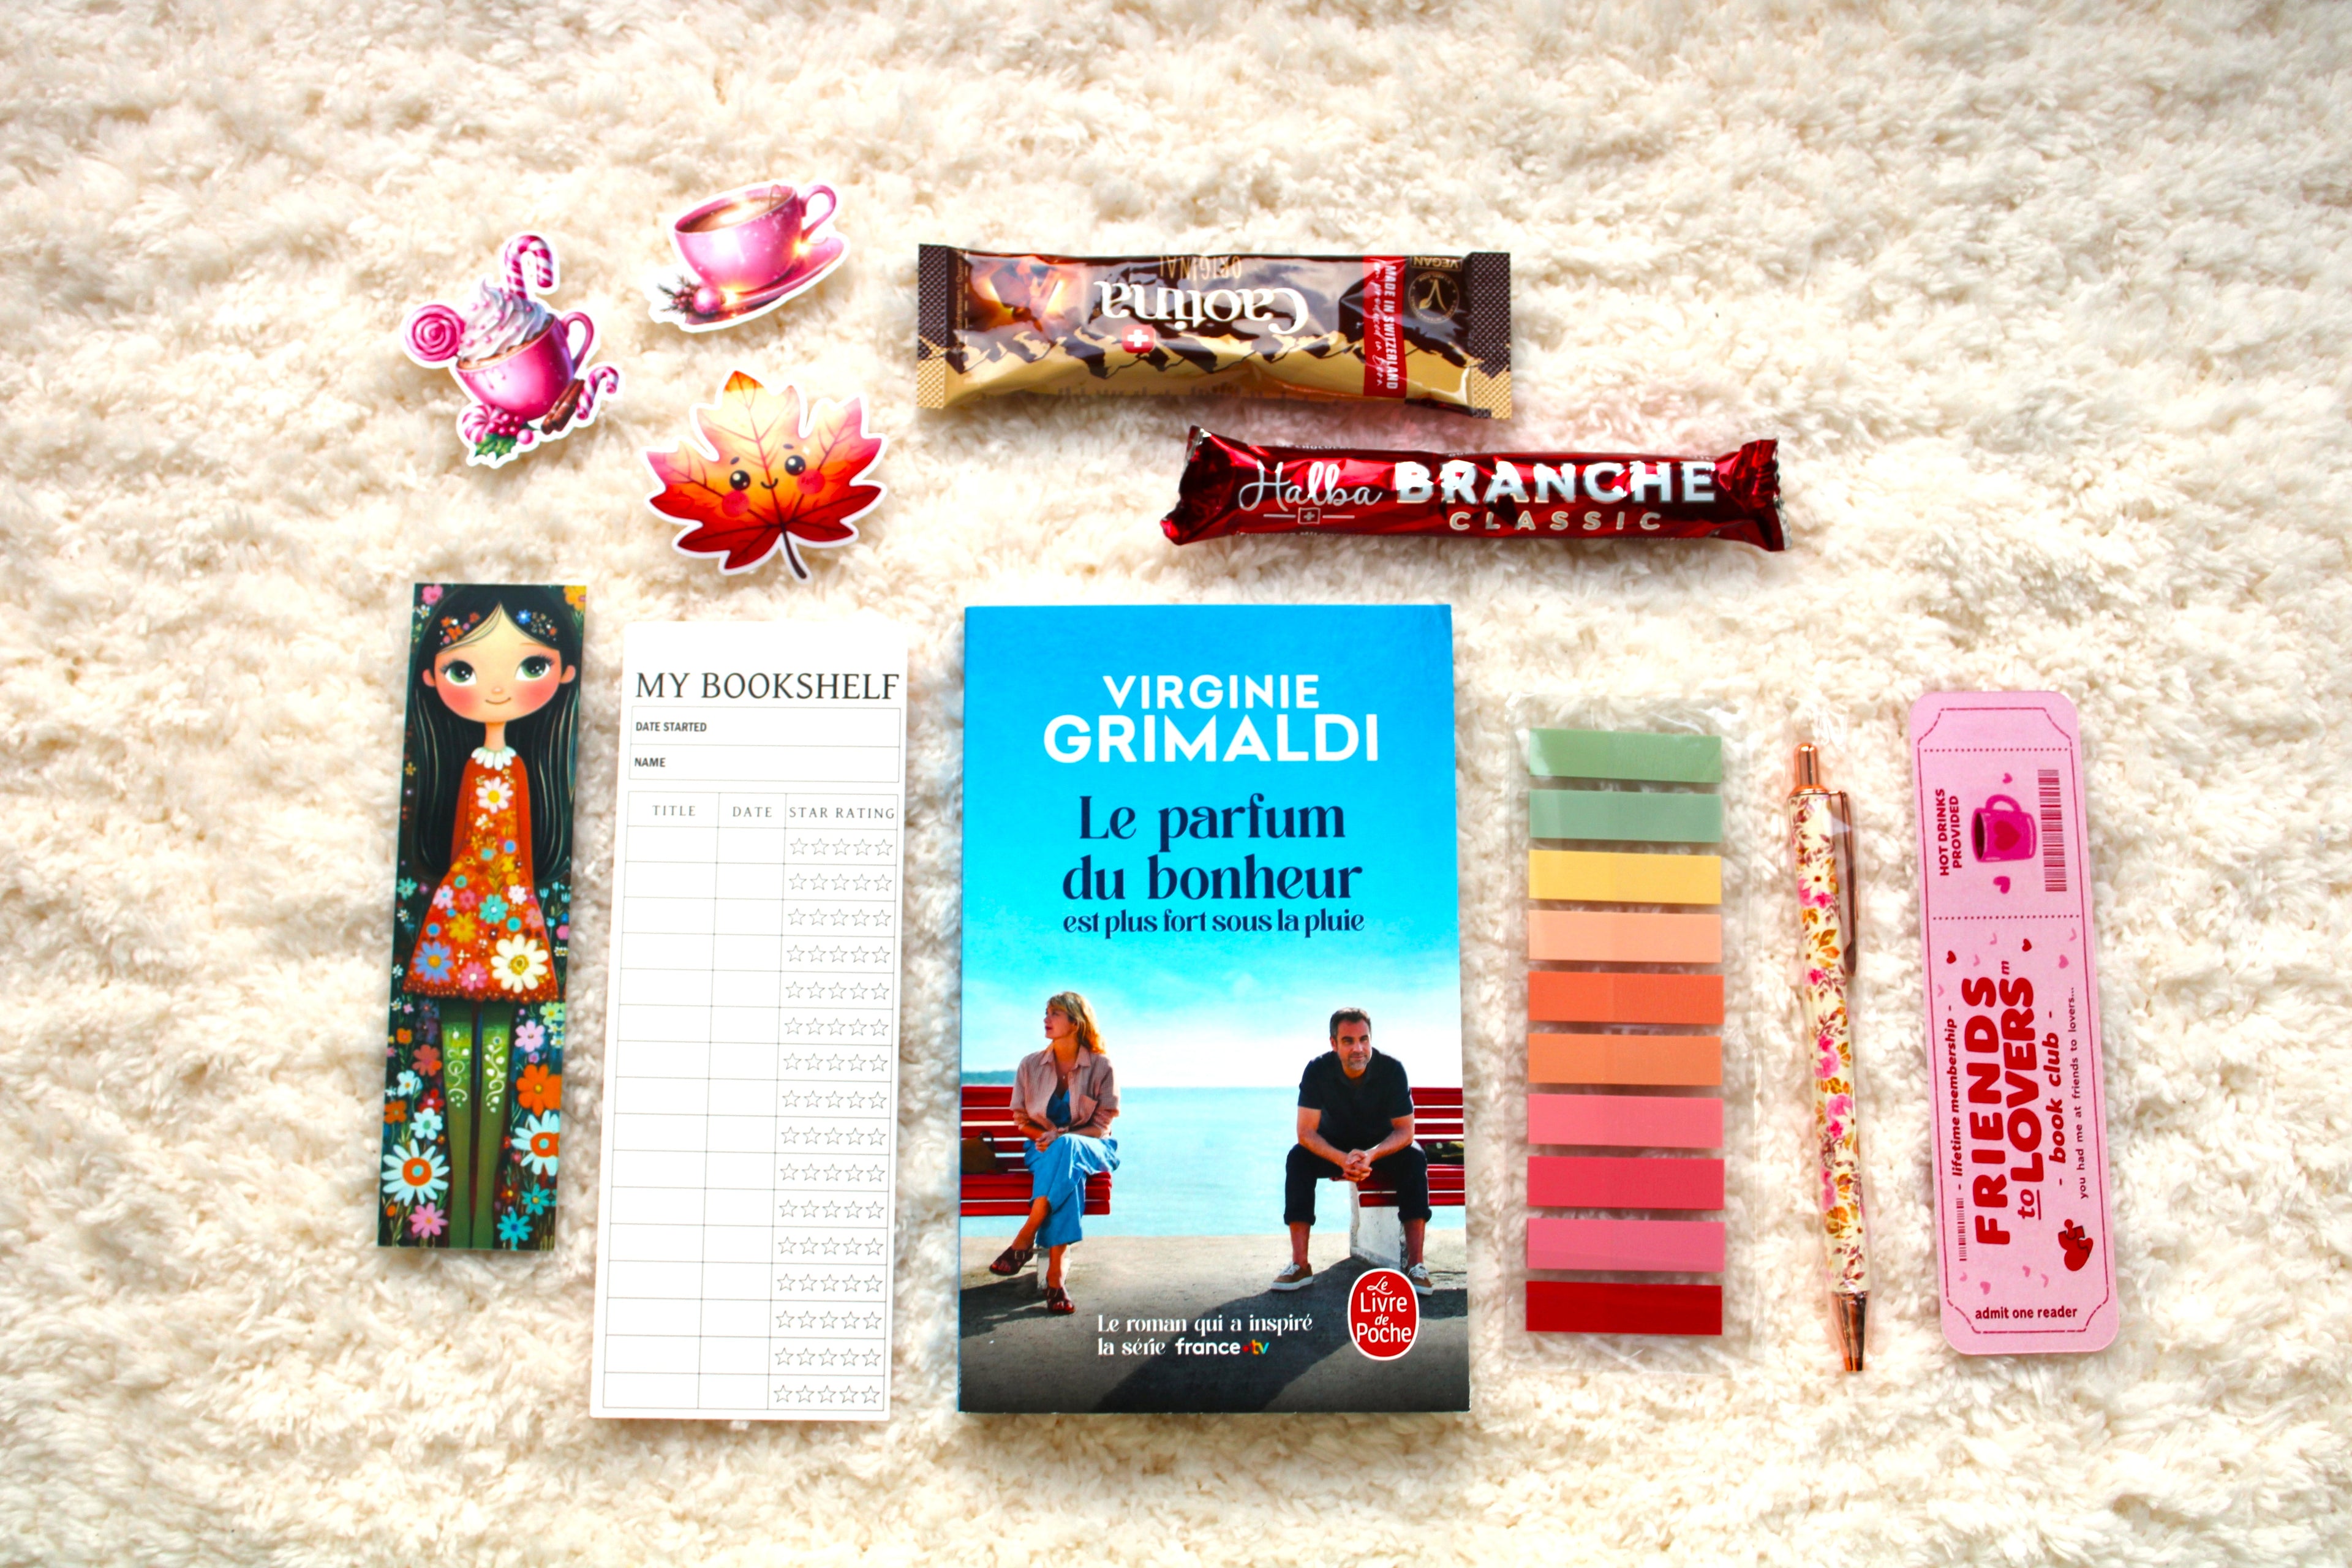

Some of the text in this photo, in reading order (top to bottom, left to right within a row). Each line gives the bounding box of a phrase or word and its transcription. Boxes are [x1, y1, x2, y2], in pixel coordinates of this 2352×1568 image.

[1413, 256, 1459, 268] VEGAN
[1093, 281, 1309, 334] Caotina
[1382, 265, 1398, 390] MADE IN SWITZERLAND
[1238, 459, 1382, 512] Halba
[1395, 461, 1716, 504] BRANCHE
[1449, 510, 1662, 531] CLASSIC
[635, 672, 900, 699] MY BOOKSHELF
[1102, 674, 1320, 710] VIRGINIE
[635, 721, 707, 733] DATE STARTED
[1043, 713, 1379, 764] GRIMALDI
[634, 757, 666, 768] NAME
[652, 804, 696, 817] TITLE
[732, 805, 773, 818] DATE
[789, 806, 895, 820] STAR RATING
[1078, 792, 1346, 853] Le parfum
[1936, 788, 1949, 876] HOT DRINKS
[1950, 796, 1962, 869] PROVIDED
[1061, 853, 1363, 900] du bonheur
[1063, 908, 1365, 939] est plus fort sous la pluie
[2070, 1039, 2078, 1052] to
[1999, 977, 2044, 1183] LOVERS
[2071, 1057, 2080, 1099] friends
[1944, 1018, 1963, 1177] lifetime membership
[2041, 1032, 2066, 1164] book club
[1961, 977, 2010, 1245] FRIENDS
[2073, 1106, 2082, 1118] at
[2076, 1123, 2083, 1142] me
[2075, 1148, 2086, 1170] had
[2080, 1177, 2089, 1199] you
[2018, 1189, 2035, 1219] to
[1366, 1275, 1393, 1295] Le
[1360, 1292, 1408, 1313] Livre
[1975, 1305, 2078, 1319] admit one reader
[1098, 1313, 1313, 1337] Le roman qui a inspiré
[1374, 1313, 1389, 1325] de
[1356, 1322, 1412, 1344] Poche
[1098, 1338, 1115, 1356] la
[1121, 1338, 1166, 1356] série
